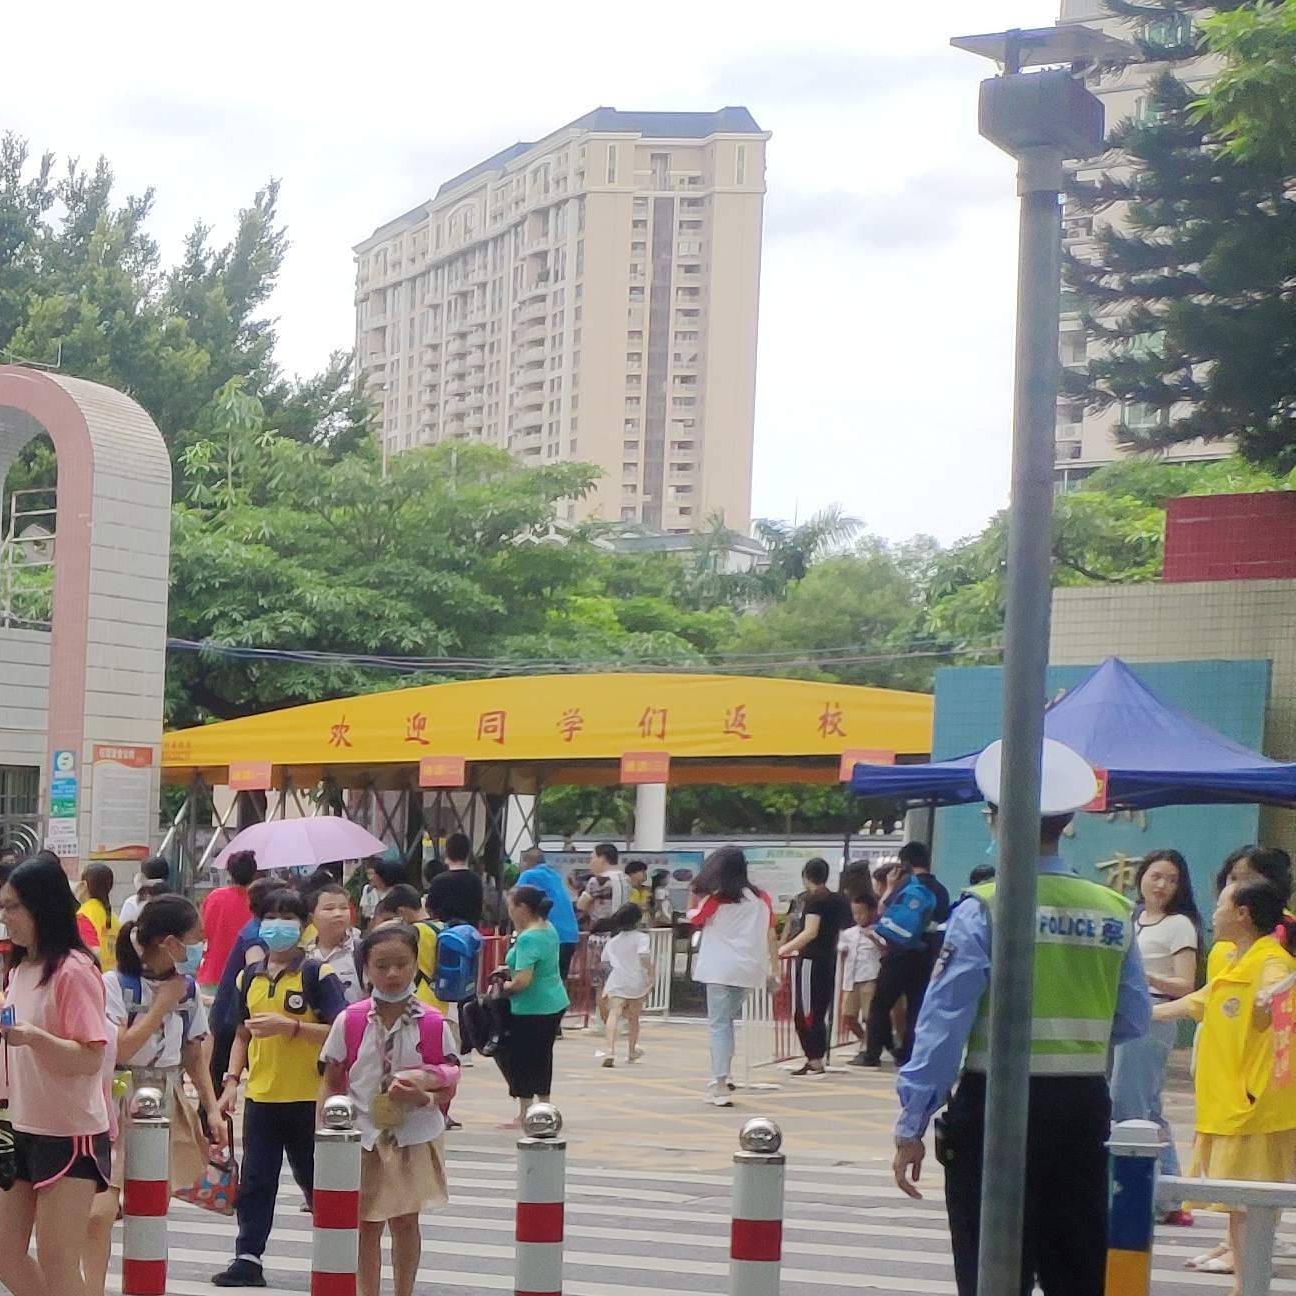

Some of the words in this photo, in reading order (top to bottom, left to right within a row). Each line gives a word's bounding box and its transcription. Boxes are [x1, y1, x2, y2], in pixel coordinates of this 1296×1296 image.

[328, 702, 847, 748] 欢迎同学们返校
[1040, 916, 1095, 937] POLICE
